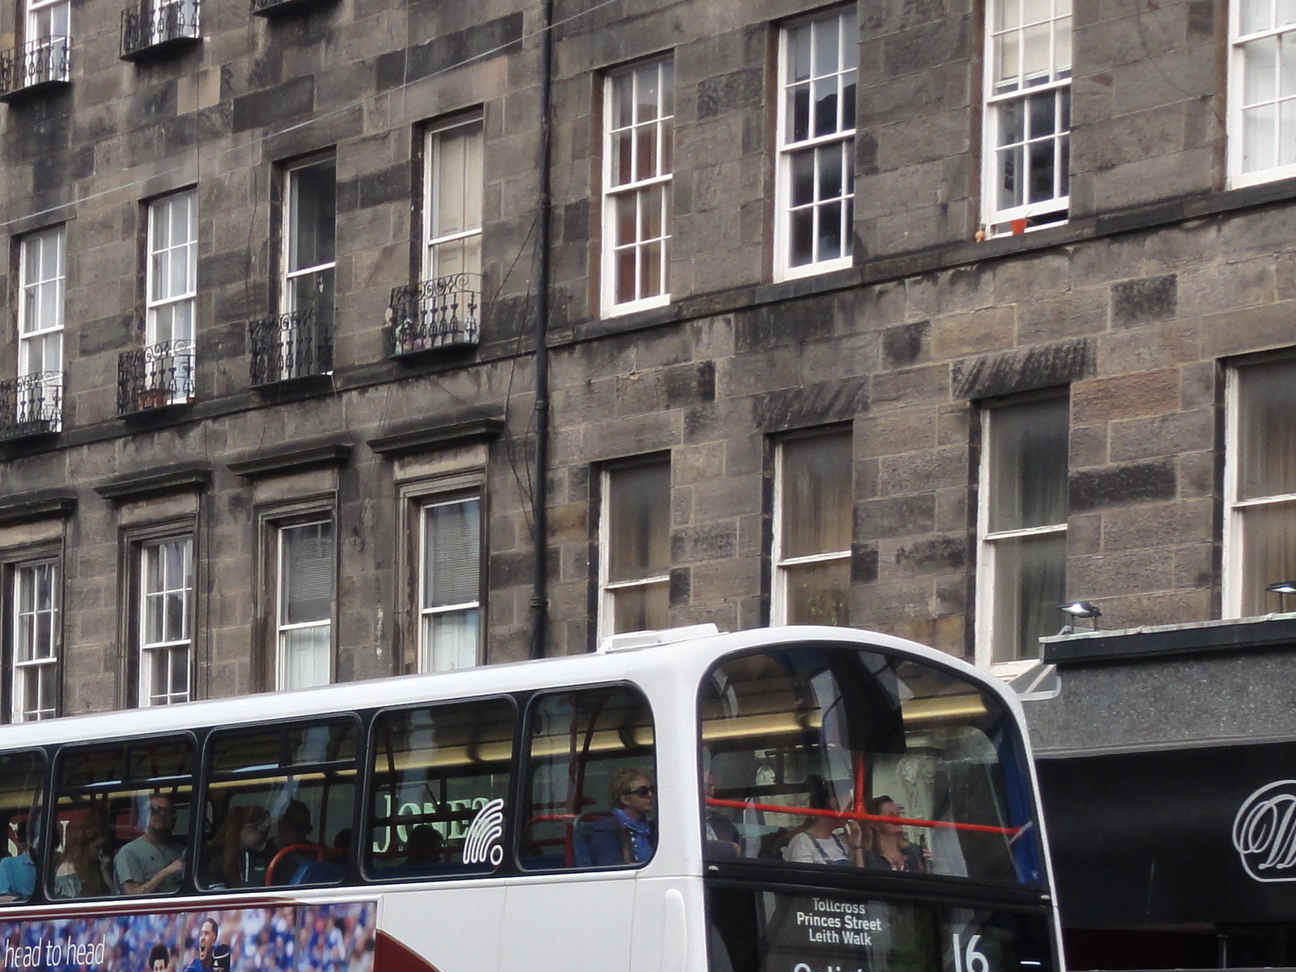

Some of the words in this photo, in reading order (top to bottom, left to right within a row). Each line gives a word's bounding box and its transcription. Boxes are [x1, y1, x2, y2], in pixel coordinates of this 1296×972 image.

[812, 898, 866, 914] Tollcross
[796, 912, 842, 928] Princes
[844, 915, 882, 931] Street
[808, 928, 840, 944] Leith
[842, 931, 872, 946] Walk
[4, 938, 42, 969] head
[46, 939, 62, 967] to
[66, 934, 105, 966] head
